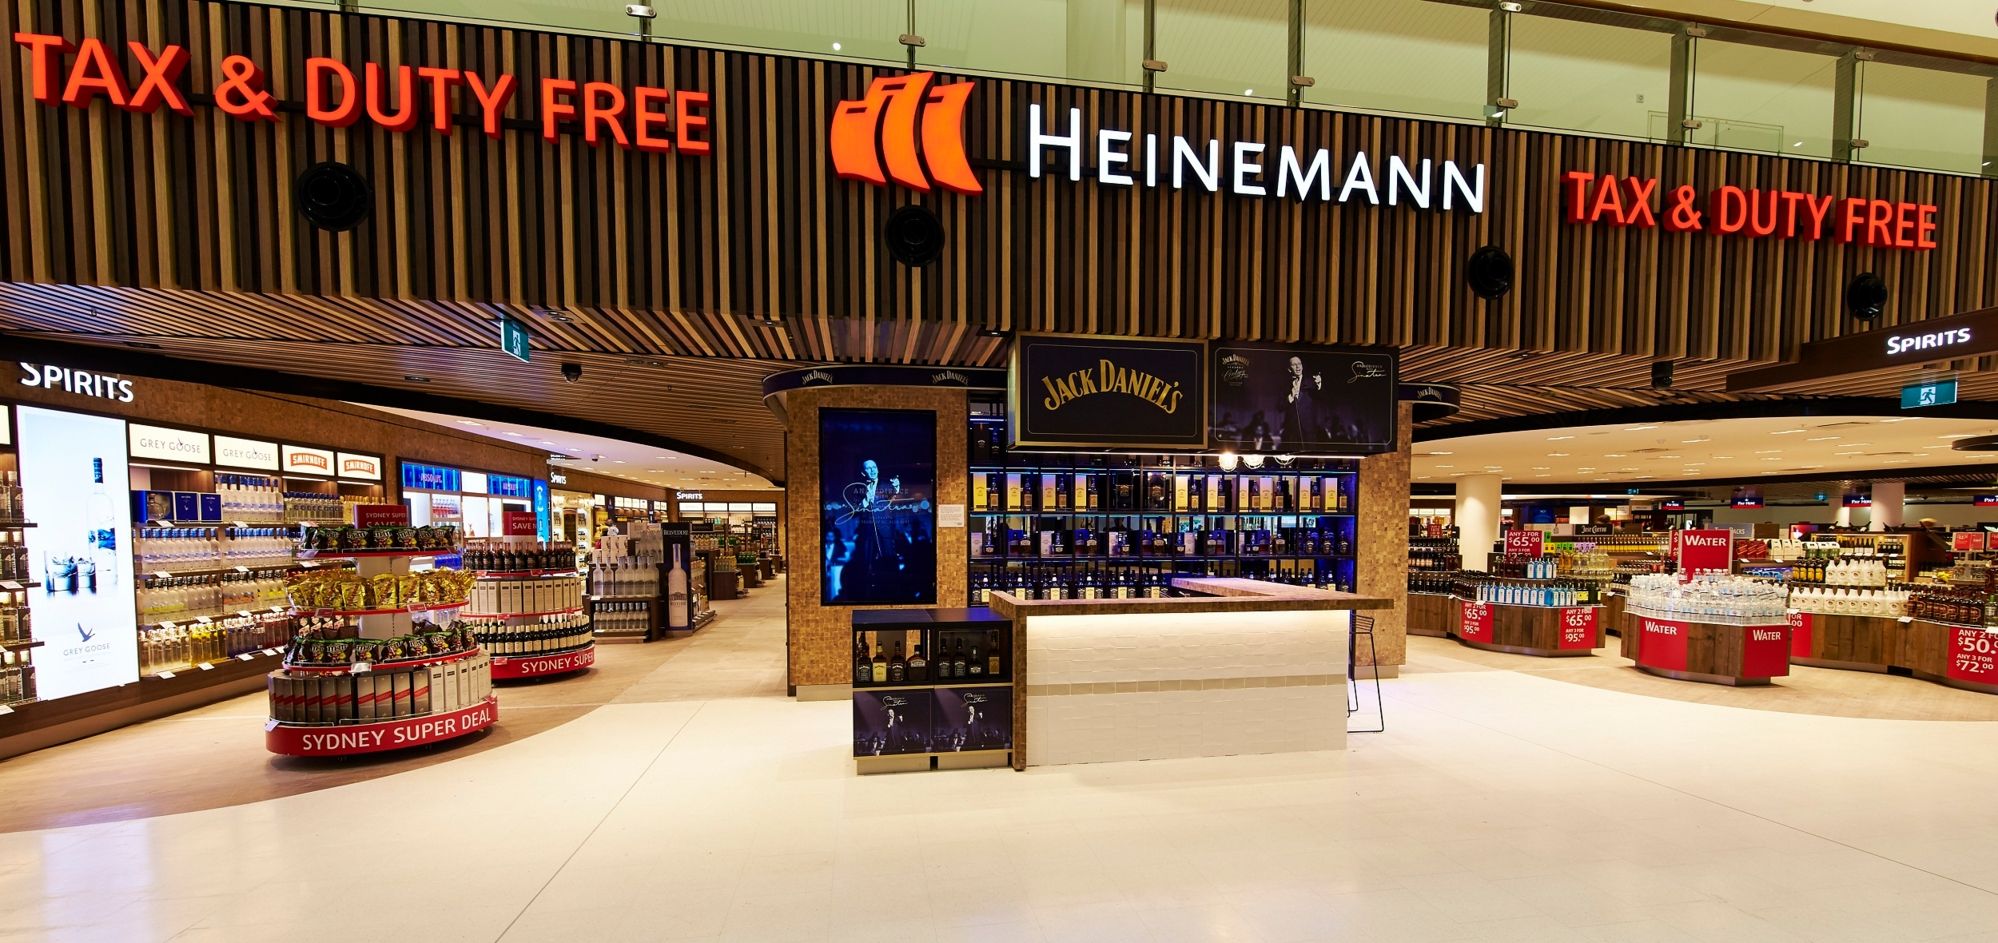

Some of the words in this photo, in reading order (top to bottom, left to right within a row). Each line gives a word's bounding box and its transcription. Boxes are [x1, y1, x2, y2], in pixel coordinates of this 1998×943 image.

[15, 32, 191, 114] TAX
[215, 55, 280, 121] &
[306, 57, 514, 137] DUTY
[542, 78, 710, 154] FREE
[1029, 103, 1485, 213] HEINEMANN
[1563, 171, 1657, 228] TAX
[1665, 185, 1702, 232] &
[1712, 186, 1832, 241] DUTY
[1836, 197, 1938, 250] FREE
[1887, 327, 1971, 356] SPIRITS
[20, 362, 133, 402] SPIRITS
[1042, 371, 1098, 411] JACK
[1099, 359, 1183, 415] DANIEL'S
[140, 438, 166, 449] GREY
[169, 440, 200, 454] GOOSE
[223, 448, 244, 458] GREY
[246, 450, 272, 461] GOOSE
[676, 491, 702, 500] SPIRITS
[512, 522, 532, 530] SAVE
[1508, 537, 1540, 547] $65.00
[1684, 535, 1726, 546] WATER
[1464, 606, 1487, 620] $65.00
[1566, 614, 1592, 627] $65.00
[1645, 621, 1677, 636] WATER
[1753, 629, 1781, 641] WATER
[1958, 629, 1977, 637] ANY
[1565, 633, 1585, 642] $95.00
[63, 648, 82, 656] GREY
[84, 643, 111, 653] GOOSE
[521, 658, 571, 674] SYDNEY
[1956, 660, 1994, 673] $72.00
[302, 729, 386, 751] SYDNEY
[393, 720, 454, 744] SUPER
[462, 708, 491, 730] DEAL
